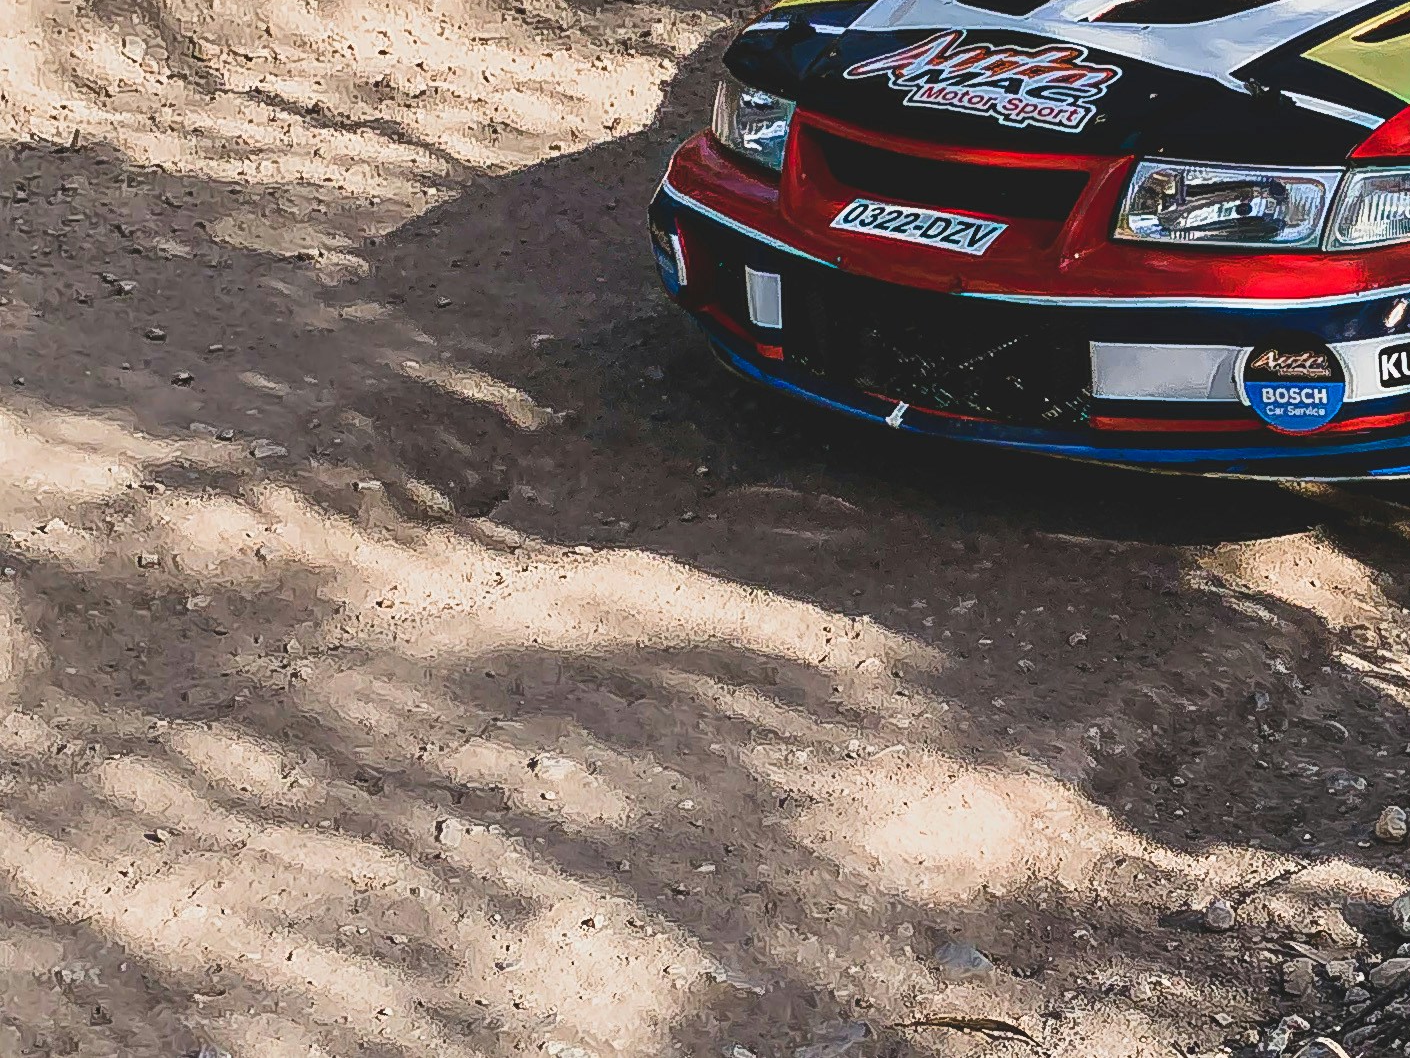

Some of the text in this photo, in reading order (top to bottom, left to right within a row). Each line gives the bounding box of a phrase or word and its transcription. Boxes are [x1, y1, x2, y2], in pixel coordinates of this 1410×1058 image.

[919, 85, 1079, 124] Motor Sport
[841, 203, 1000, 249] 0322-DZV
[1262, 387, 1328, 404] BOSCH
[1266, 404, 1326, 416] Car Service
